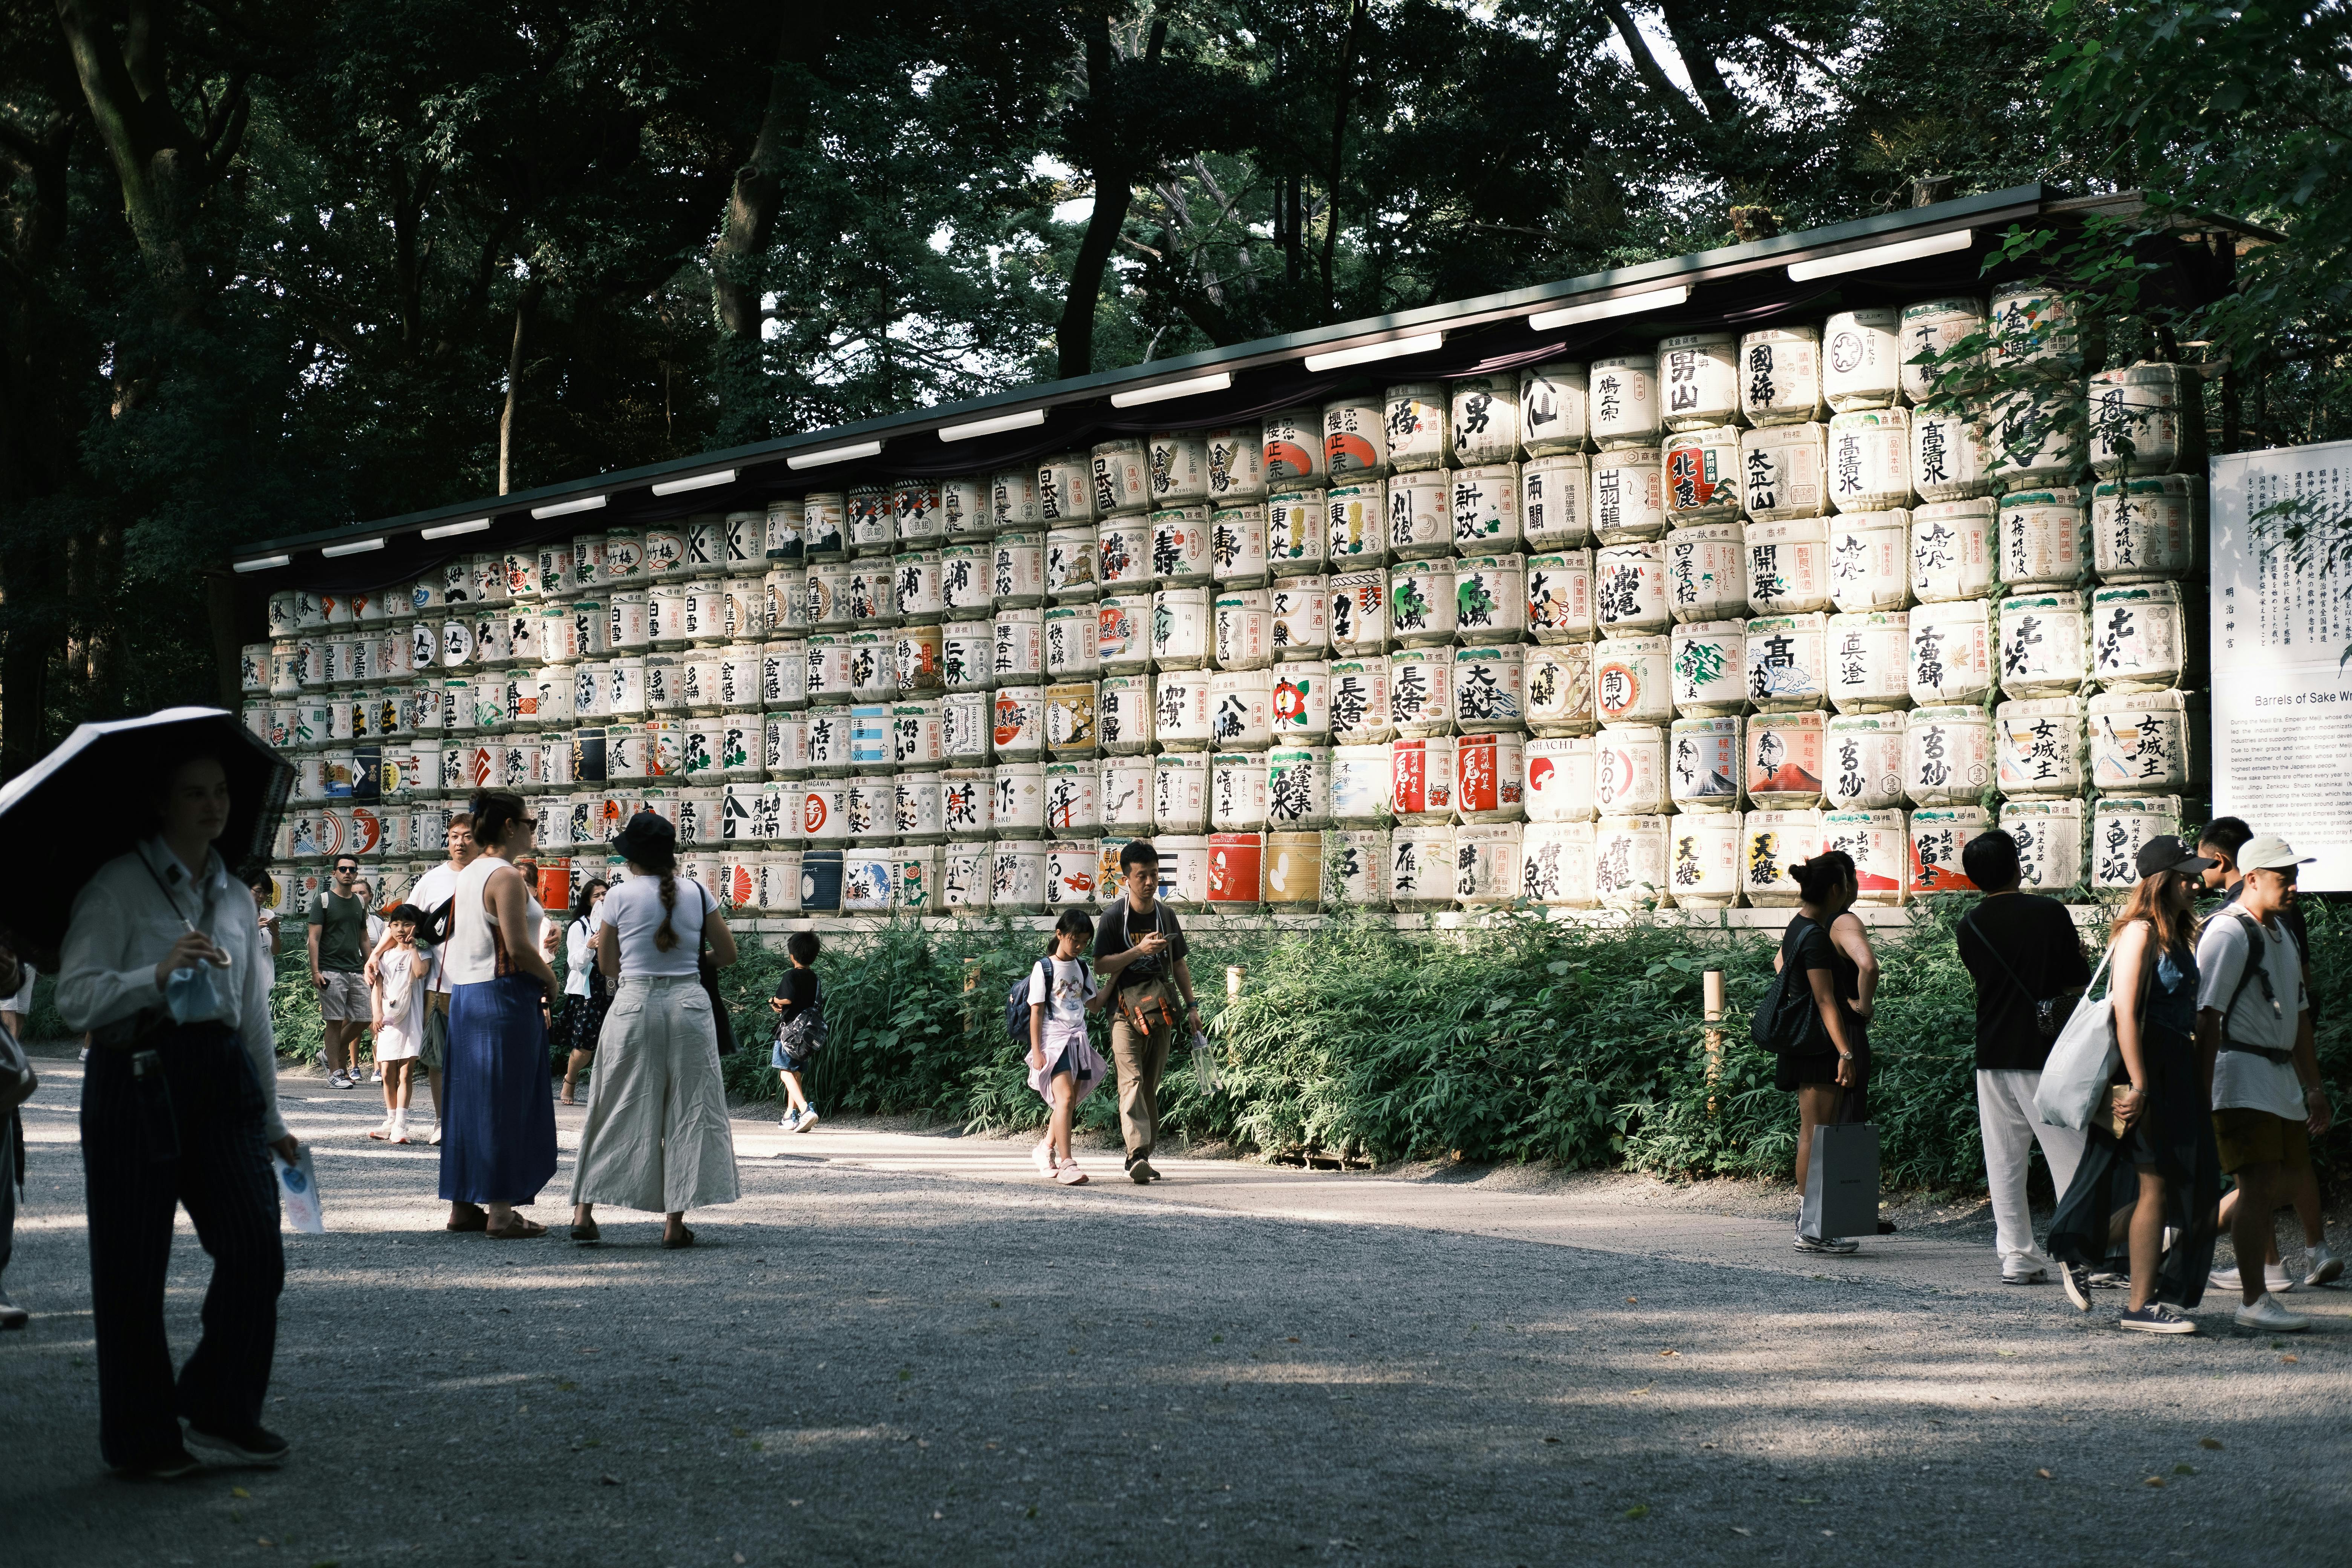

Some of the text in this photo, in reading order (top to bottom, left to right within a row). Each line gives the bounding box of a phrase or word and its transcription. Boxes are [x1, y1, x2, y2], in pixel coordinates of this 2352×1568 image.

[1188, 444, 1197, 474] キンシ正宗
[1890, 439, 1899, 474] 品質本位
[1040, 470, 1060, 521] 日本盛
[1599, 470, 1619, 528] 出羽鶴
[1673, 453, 1698, 508] 北鹿
[1748, 449, 1775, 510] 太平山
[1271, 508, 1288, 558] 東光
[1456, 483, 1486, 539] 新政
[1251, 533, 1260, 554] 清酒
[1653, 573, 1662, 595] 清酒
[1675, 544, 1697, 603] 四季桜
[687, 597, 698, 632] 白雪
[807, 577, 821, 623] 月桂冠
[2225, 586, 2234, 648] 明治神宮
[576, 614, 589, 654] 七賢
[612, 606, 620, 642] 白雪
[1249, 617, 1258, 655] 芳醇清酒
[808, 649, 825, 691] 岩の井
[946, 640, 965, 685] 仁勇
[996, 626, 1012, 672] 腰古井
[1031, 630, 1039, 667] 芳醇清酒
[722, 663, 735, 702] 金婚
[1530, 663, 1559, 706] 雪中梅
[1605, 672, 1625, 710] 菊水
[2256, 695, 2292, 706] Barrels
[2296, 693, 2306, 703] of
[2310, 692, 2336, 703] Sake
[1102, 693, 1119, 742] 柏露
[1213, 695, 1250, 743] 八海山
[2030, 718, 2058, 780] 女城主
[2135, 715, 2165, 778] 女城主
[1602, 748, 1615, 803] ねのひ
[751, 799, 763, 836] 月の桂
[2147, 803, 2166, 812] 商標
[1917, 834, 1939, 886] 富士
[1940, 830, 1952, 861] 出雲
